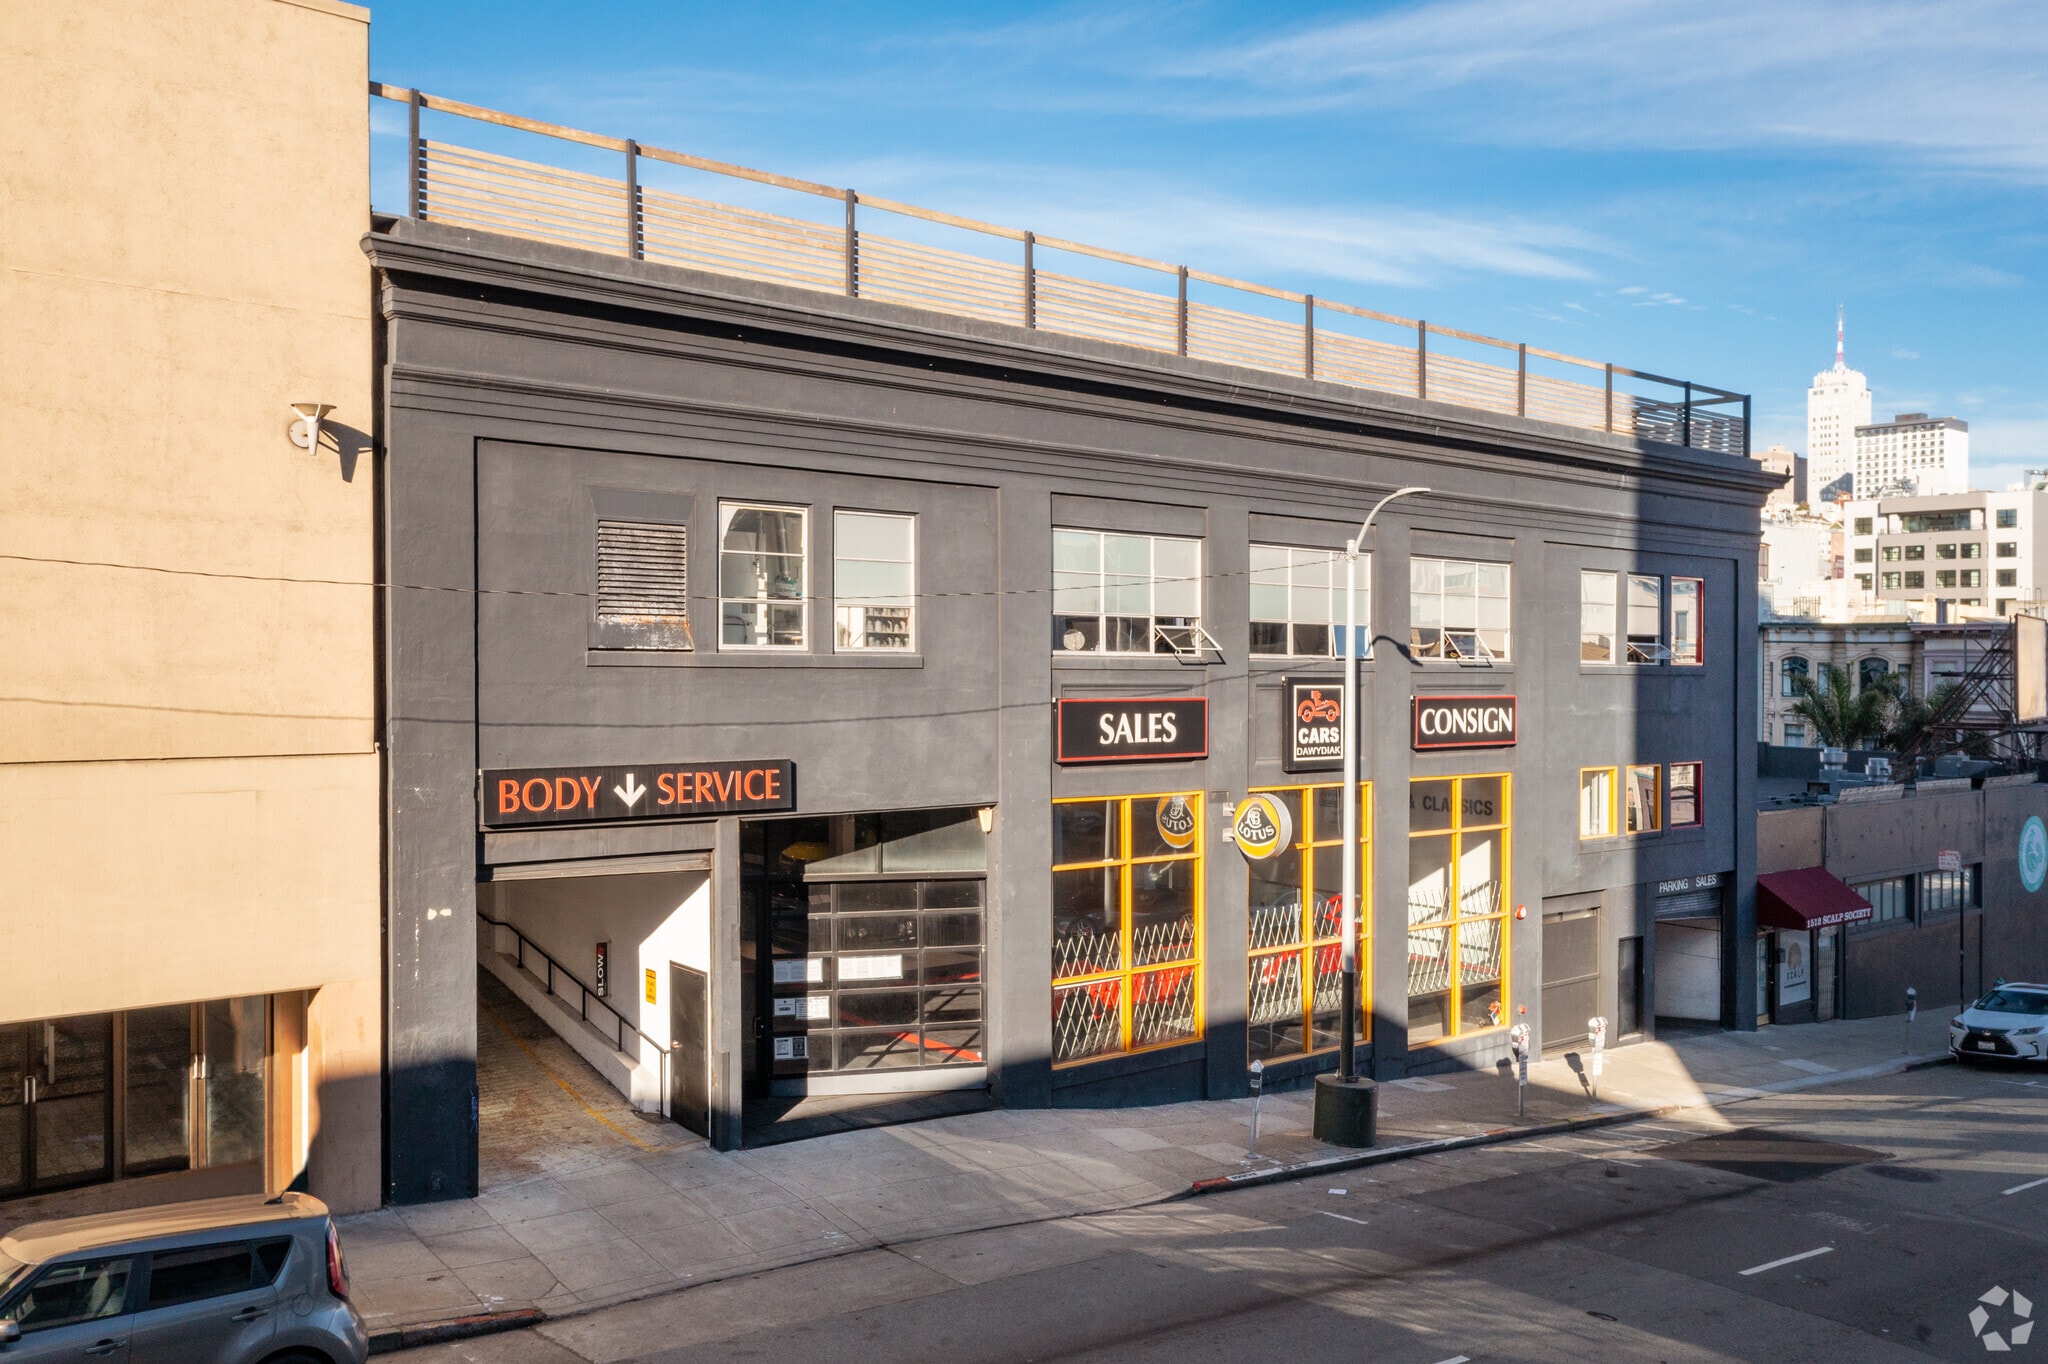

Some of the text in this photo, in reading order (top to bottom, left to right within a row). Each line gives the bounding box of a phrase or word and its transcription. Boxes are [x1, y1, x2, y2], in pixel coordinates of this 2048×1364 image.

[1099, 712, 1178, 745] SALES
[1420, 707, 1513, 735] CONSIGN
[1298, 727, 1340, 744] CARS
[1296, 746, 1341, 756] DAWYDIAK
[498, 769, 780, 813] BODY SERVICE
[1422, 795, 1494, 816] CLASICS
[1239, 823, 1275, 841] LOTUS
[1659, 874, 1717, 893] PARKING SALES
[1822, 912, 1844, 925] SCALP
[1844, 907, 1872, 921] SOCIETY
